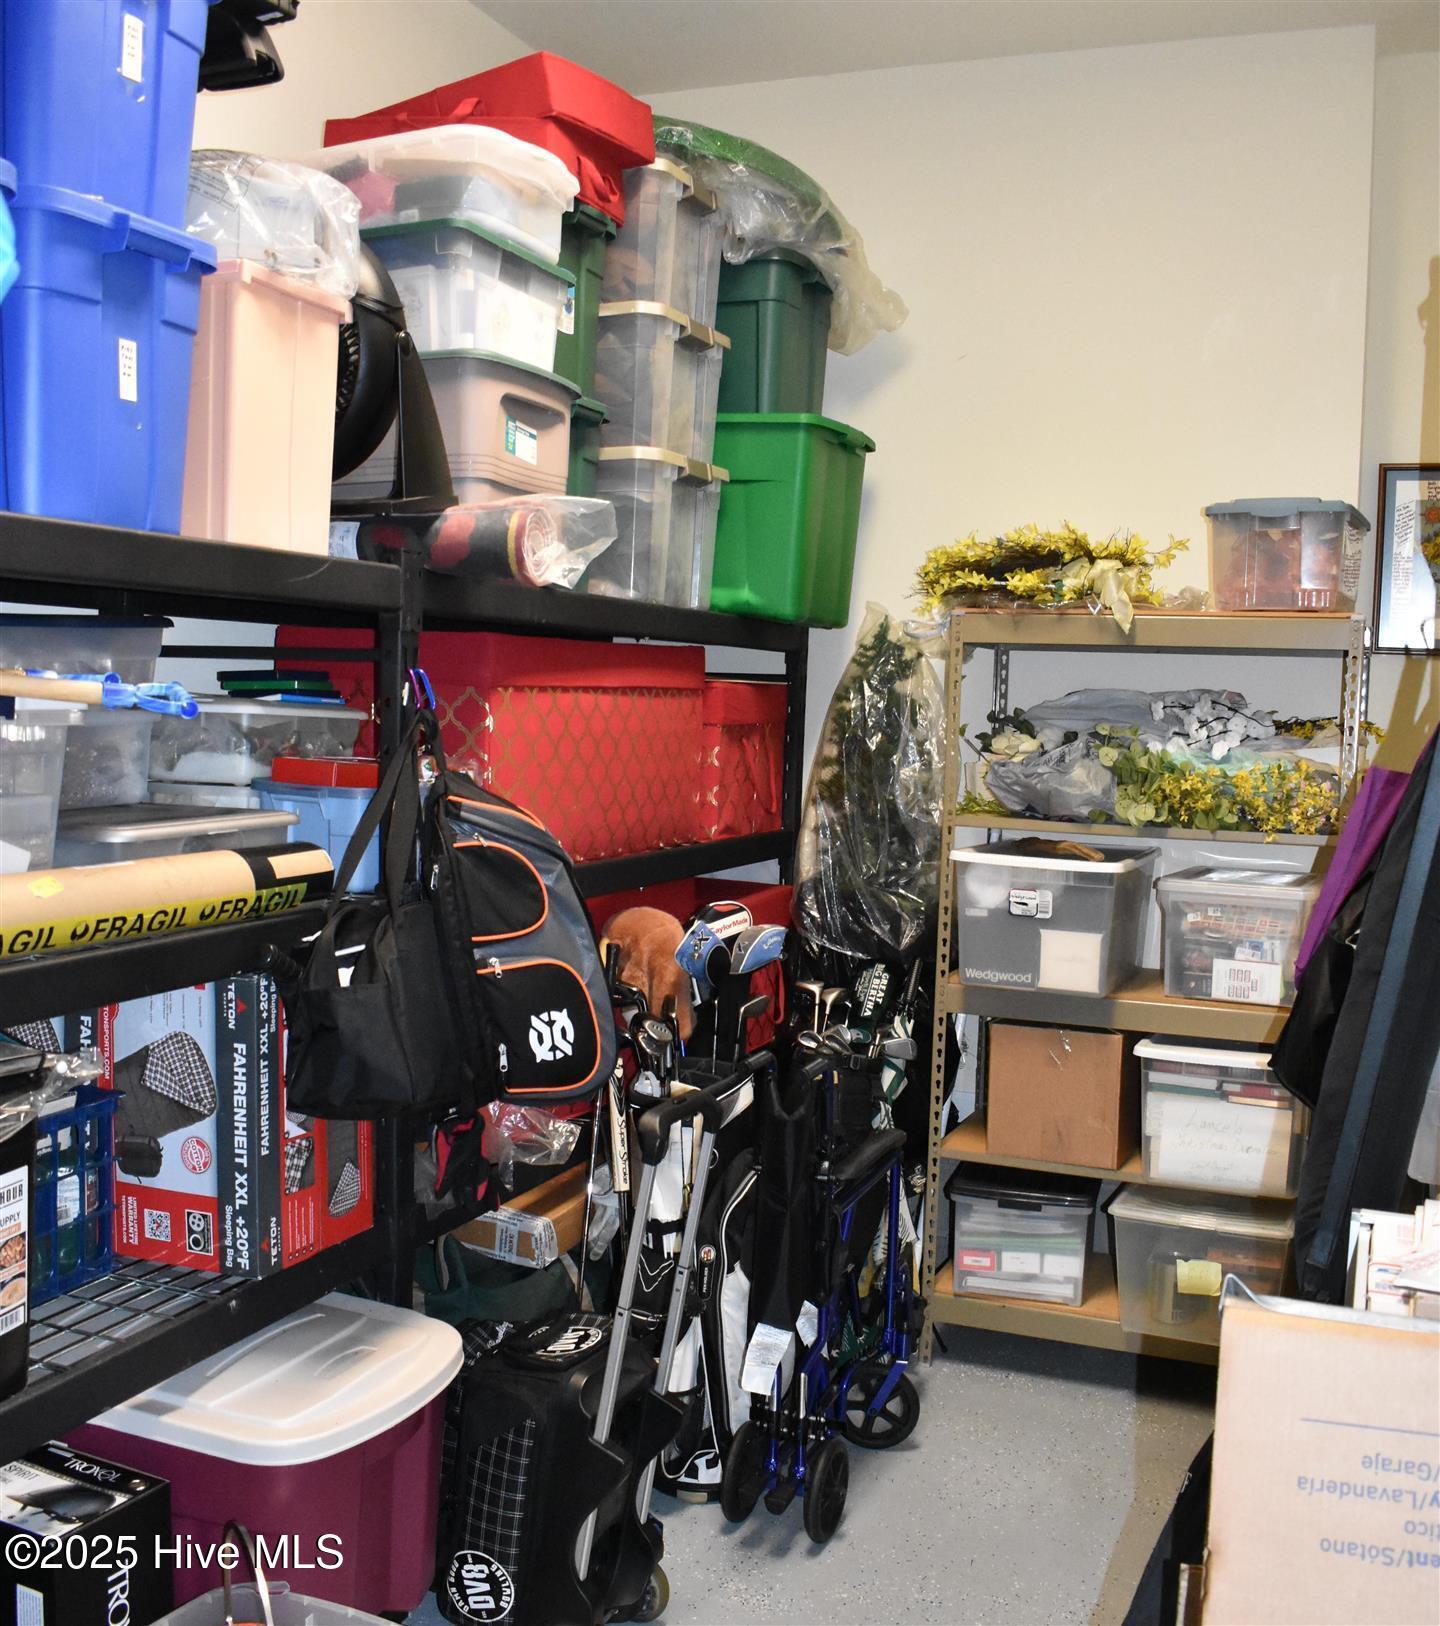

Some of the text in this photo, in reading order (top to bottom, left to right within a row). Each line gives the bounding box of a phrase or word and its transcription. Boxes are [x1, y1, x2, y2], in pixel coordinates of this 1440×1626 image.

[89, 906, 188, 942] FRAGIL
[212, 889, 301, 922] FRAGIL
[863, 979, 881, 1017] BERTHA
[876, 972, 890, 1005] GREAT
[964, 967, 1033, 984] Wedgwood
[227, 982, 236, 1031] TETON
[260, 1023, 269, 1056] XXL
[233, 1042, 248, 1168] FAHRENHEIT
[260, 1059, 270, 1156] FAHRENHEIT
[234, 1171, 249, 1210] XXL
[127, 1196, 135, 1244] WARRANTY
[225, 1204, 234, 1268] Sleeping Bag
[269, 1217, 278, 1266] TETON
[4, 1463, 39, 1482] SPIRIT
[461, 1564, 496, 1609] DV8
[490, 1563, 511, 1609] BOWLING
